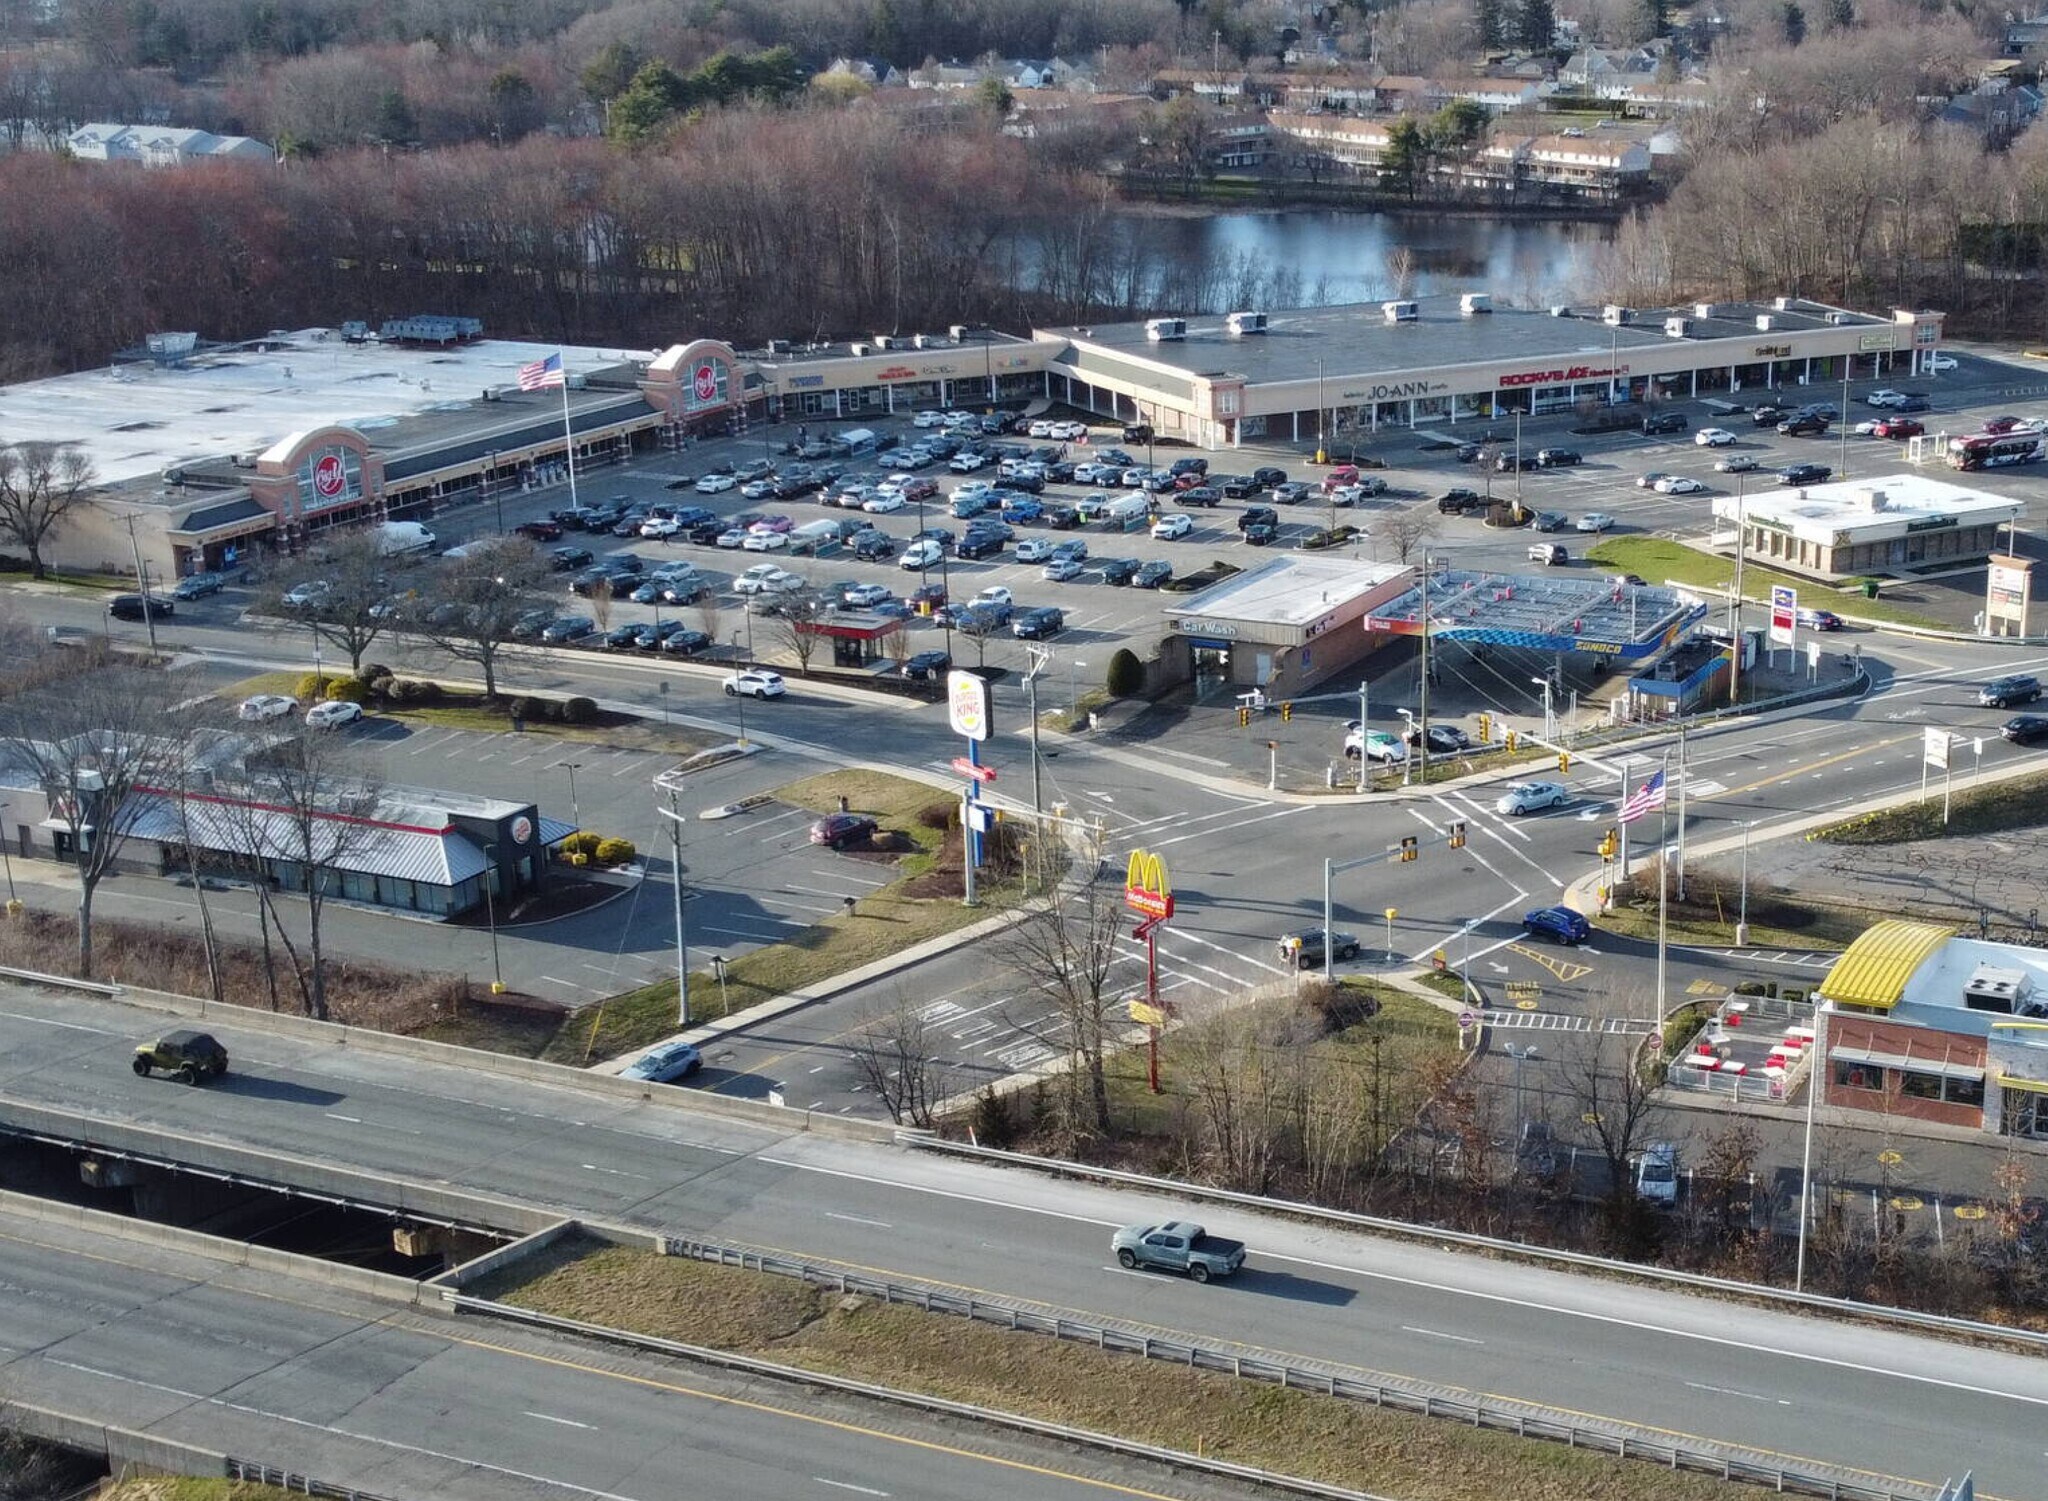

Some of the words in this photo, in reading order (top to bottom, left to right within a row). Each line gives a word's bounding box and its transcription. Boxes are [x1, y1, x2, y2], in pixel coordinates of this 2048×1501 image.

[1566, 366, 1590, 380] ACE
[1183, 621, 1201, 632] Car
[1204, 621, 1236, 636] Wash
[1575, 641, 1622, 654] SUNOCO
[956, 702, 979, 718] KING
